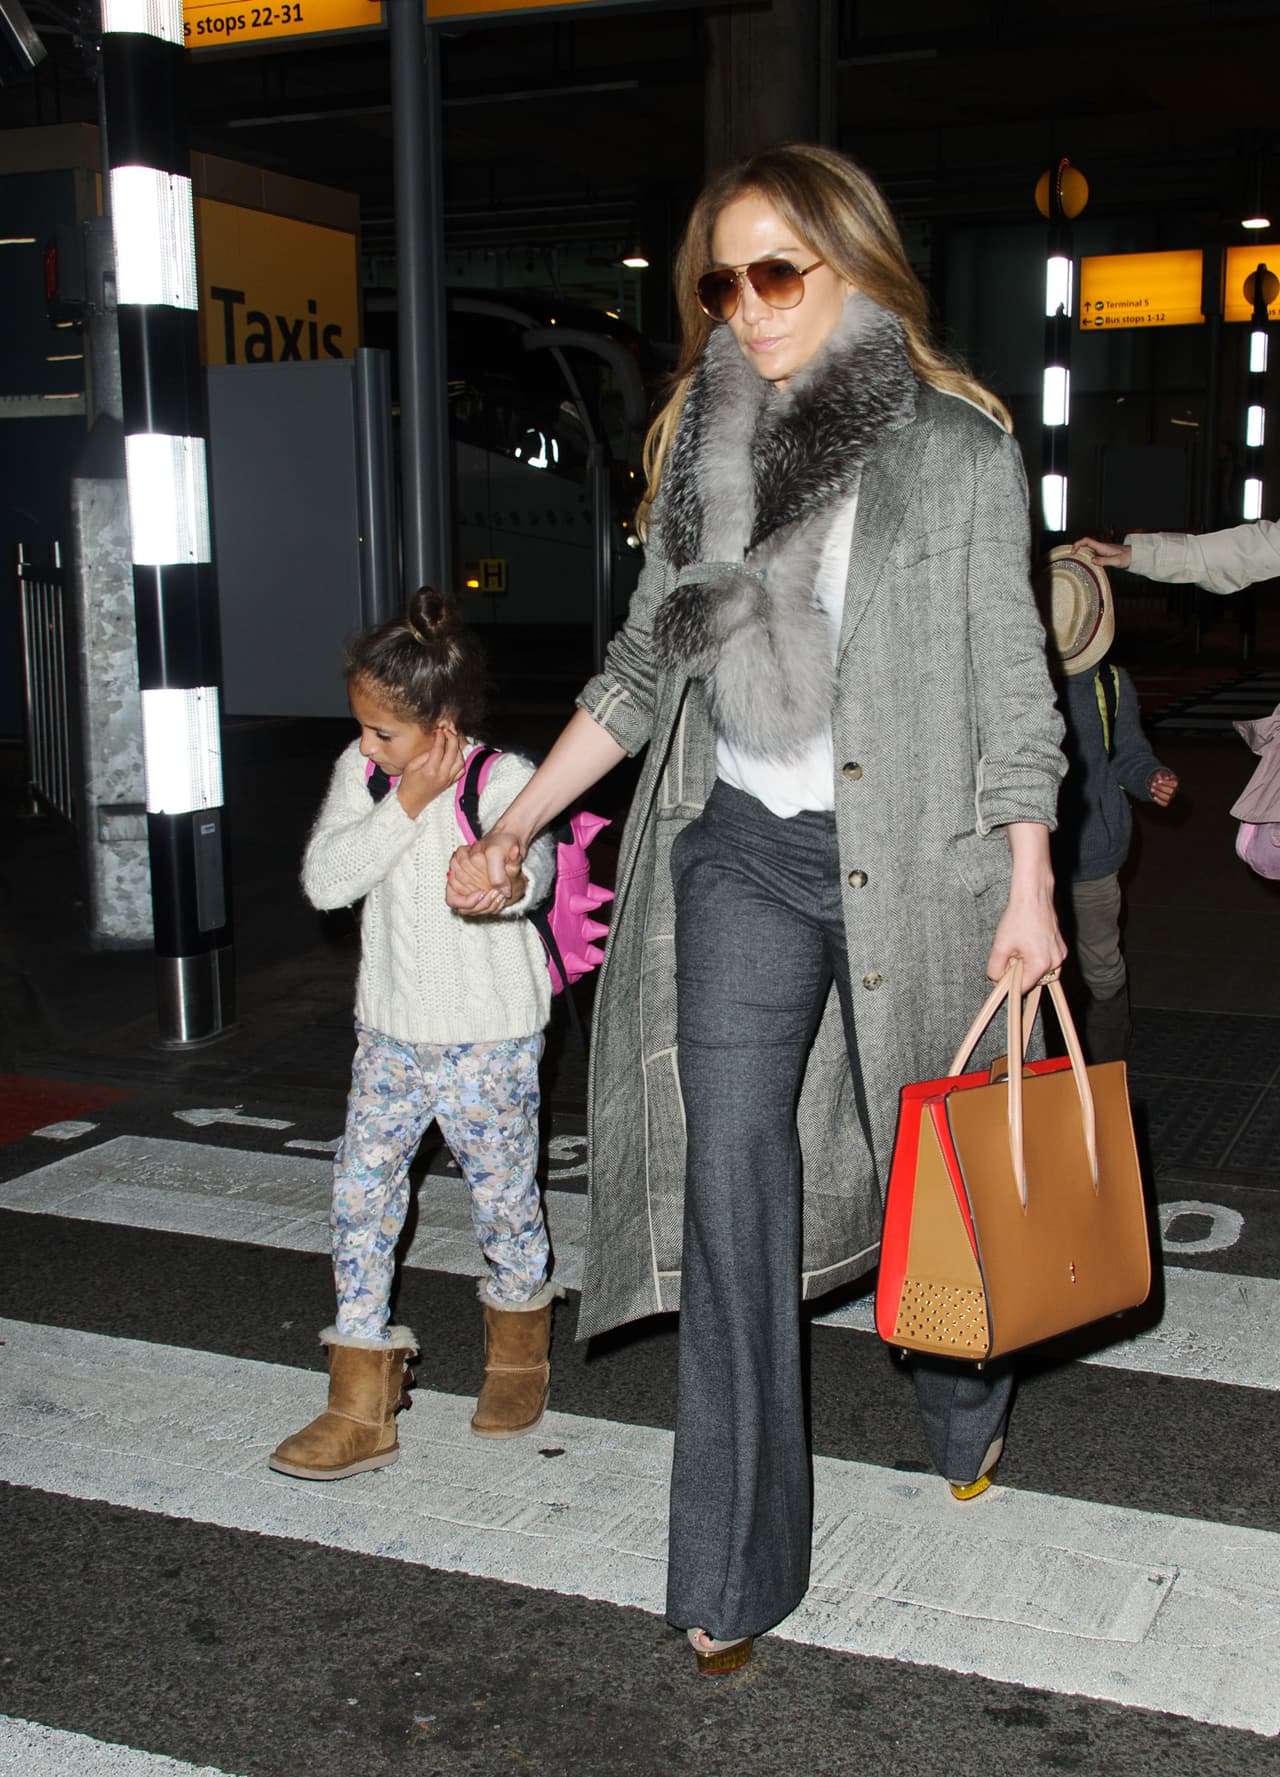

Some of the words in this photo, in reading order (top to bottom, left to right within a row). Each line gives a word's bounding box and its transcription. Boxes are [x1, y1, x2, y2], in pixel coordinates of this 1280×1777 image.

[184, 22, 191, 36] s
[197, 14, 246, 36] stops
[251, 3, 304, 28] 22-31
[1106, 300, 1143, 309] Terminal
[1144, 299, 1150, 307] 5
[211, 286, 344, 365] Taxis
[1105, 316, 1120, 324] Bus
[1122, 315, 1145, 324] stops
[1147, 313, 1165, 322] 1-12
[484, 562, 502, 589] H
